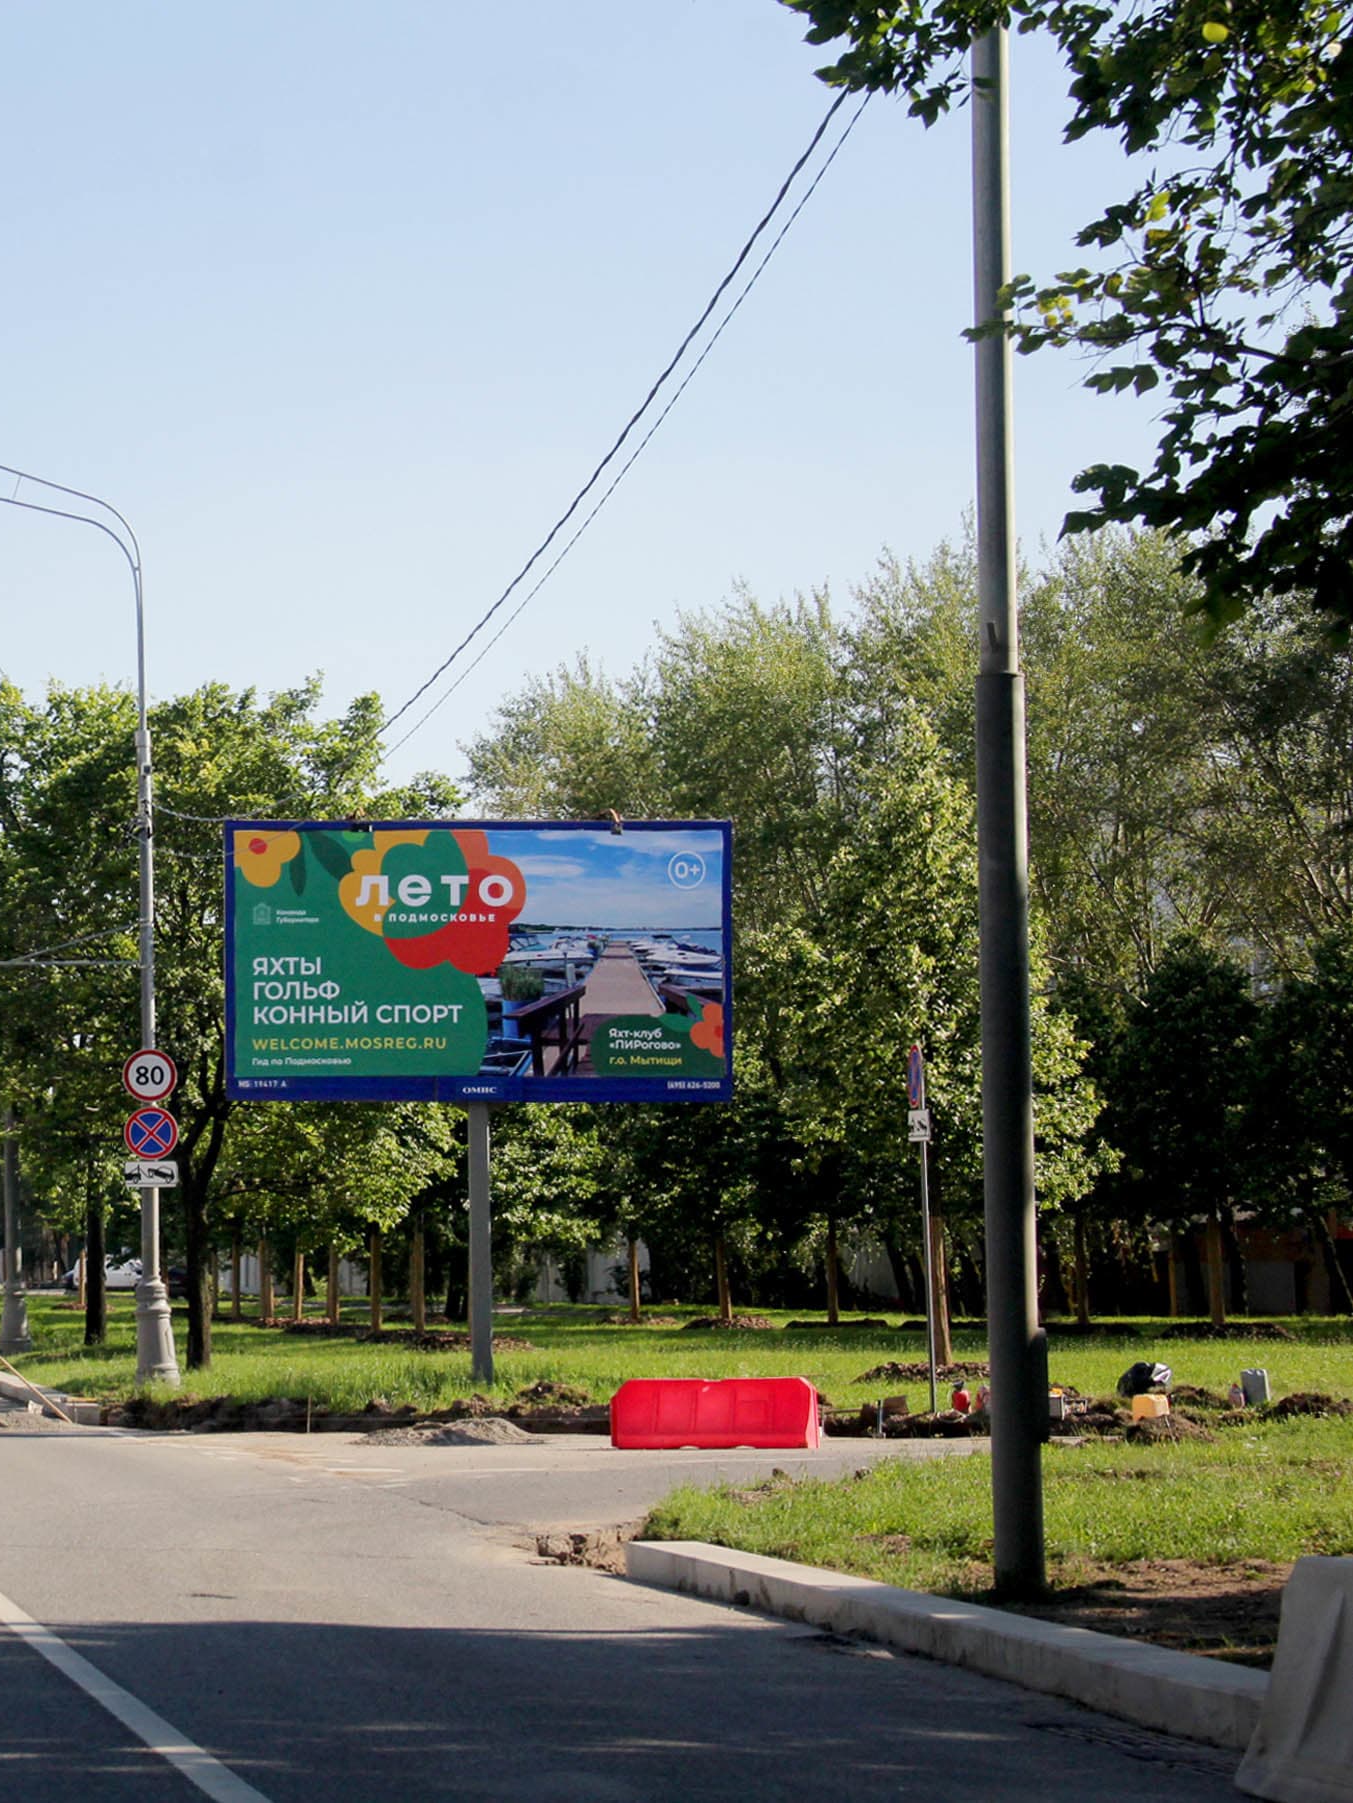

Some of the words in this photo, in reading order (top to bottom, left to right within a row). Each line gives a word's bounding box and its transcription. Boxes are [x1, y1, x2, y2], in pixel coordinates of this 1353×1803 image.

[675, 862, 701, 879] 0+
[355, 874, 514, 907] лето
[252, 956, 322, 976] ЯХТЫ
[253, 980, 341, 1001] ГОЛЬФ
[253, 1000, 369, 1025] КОННЫЙ
[375, 1004, 464, 1025] СПОРТ
[609, 1027, 663, 1041] Яхт-клуб
[252, 1037, 448, 1051] WELCOME.MOSREG.RU
[252, 1057, 270, 1067] Гид
[271, 1058, 284, 1066] по
[285, 1056, 352, 1067] Подмосковью
[630, 1055, 683, 1066] Мытищи
[136, 1065, 165, 1086] 80
